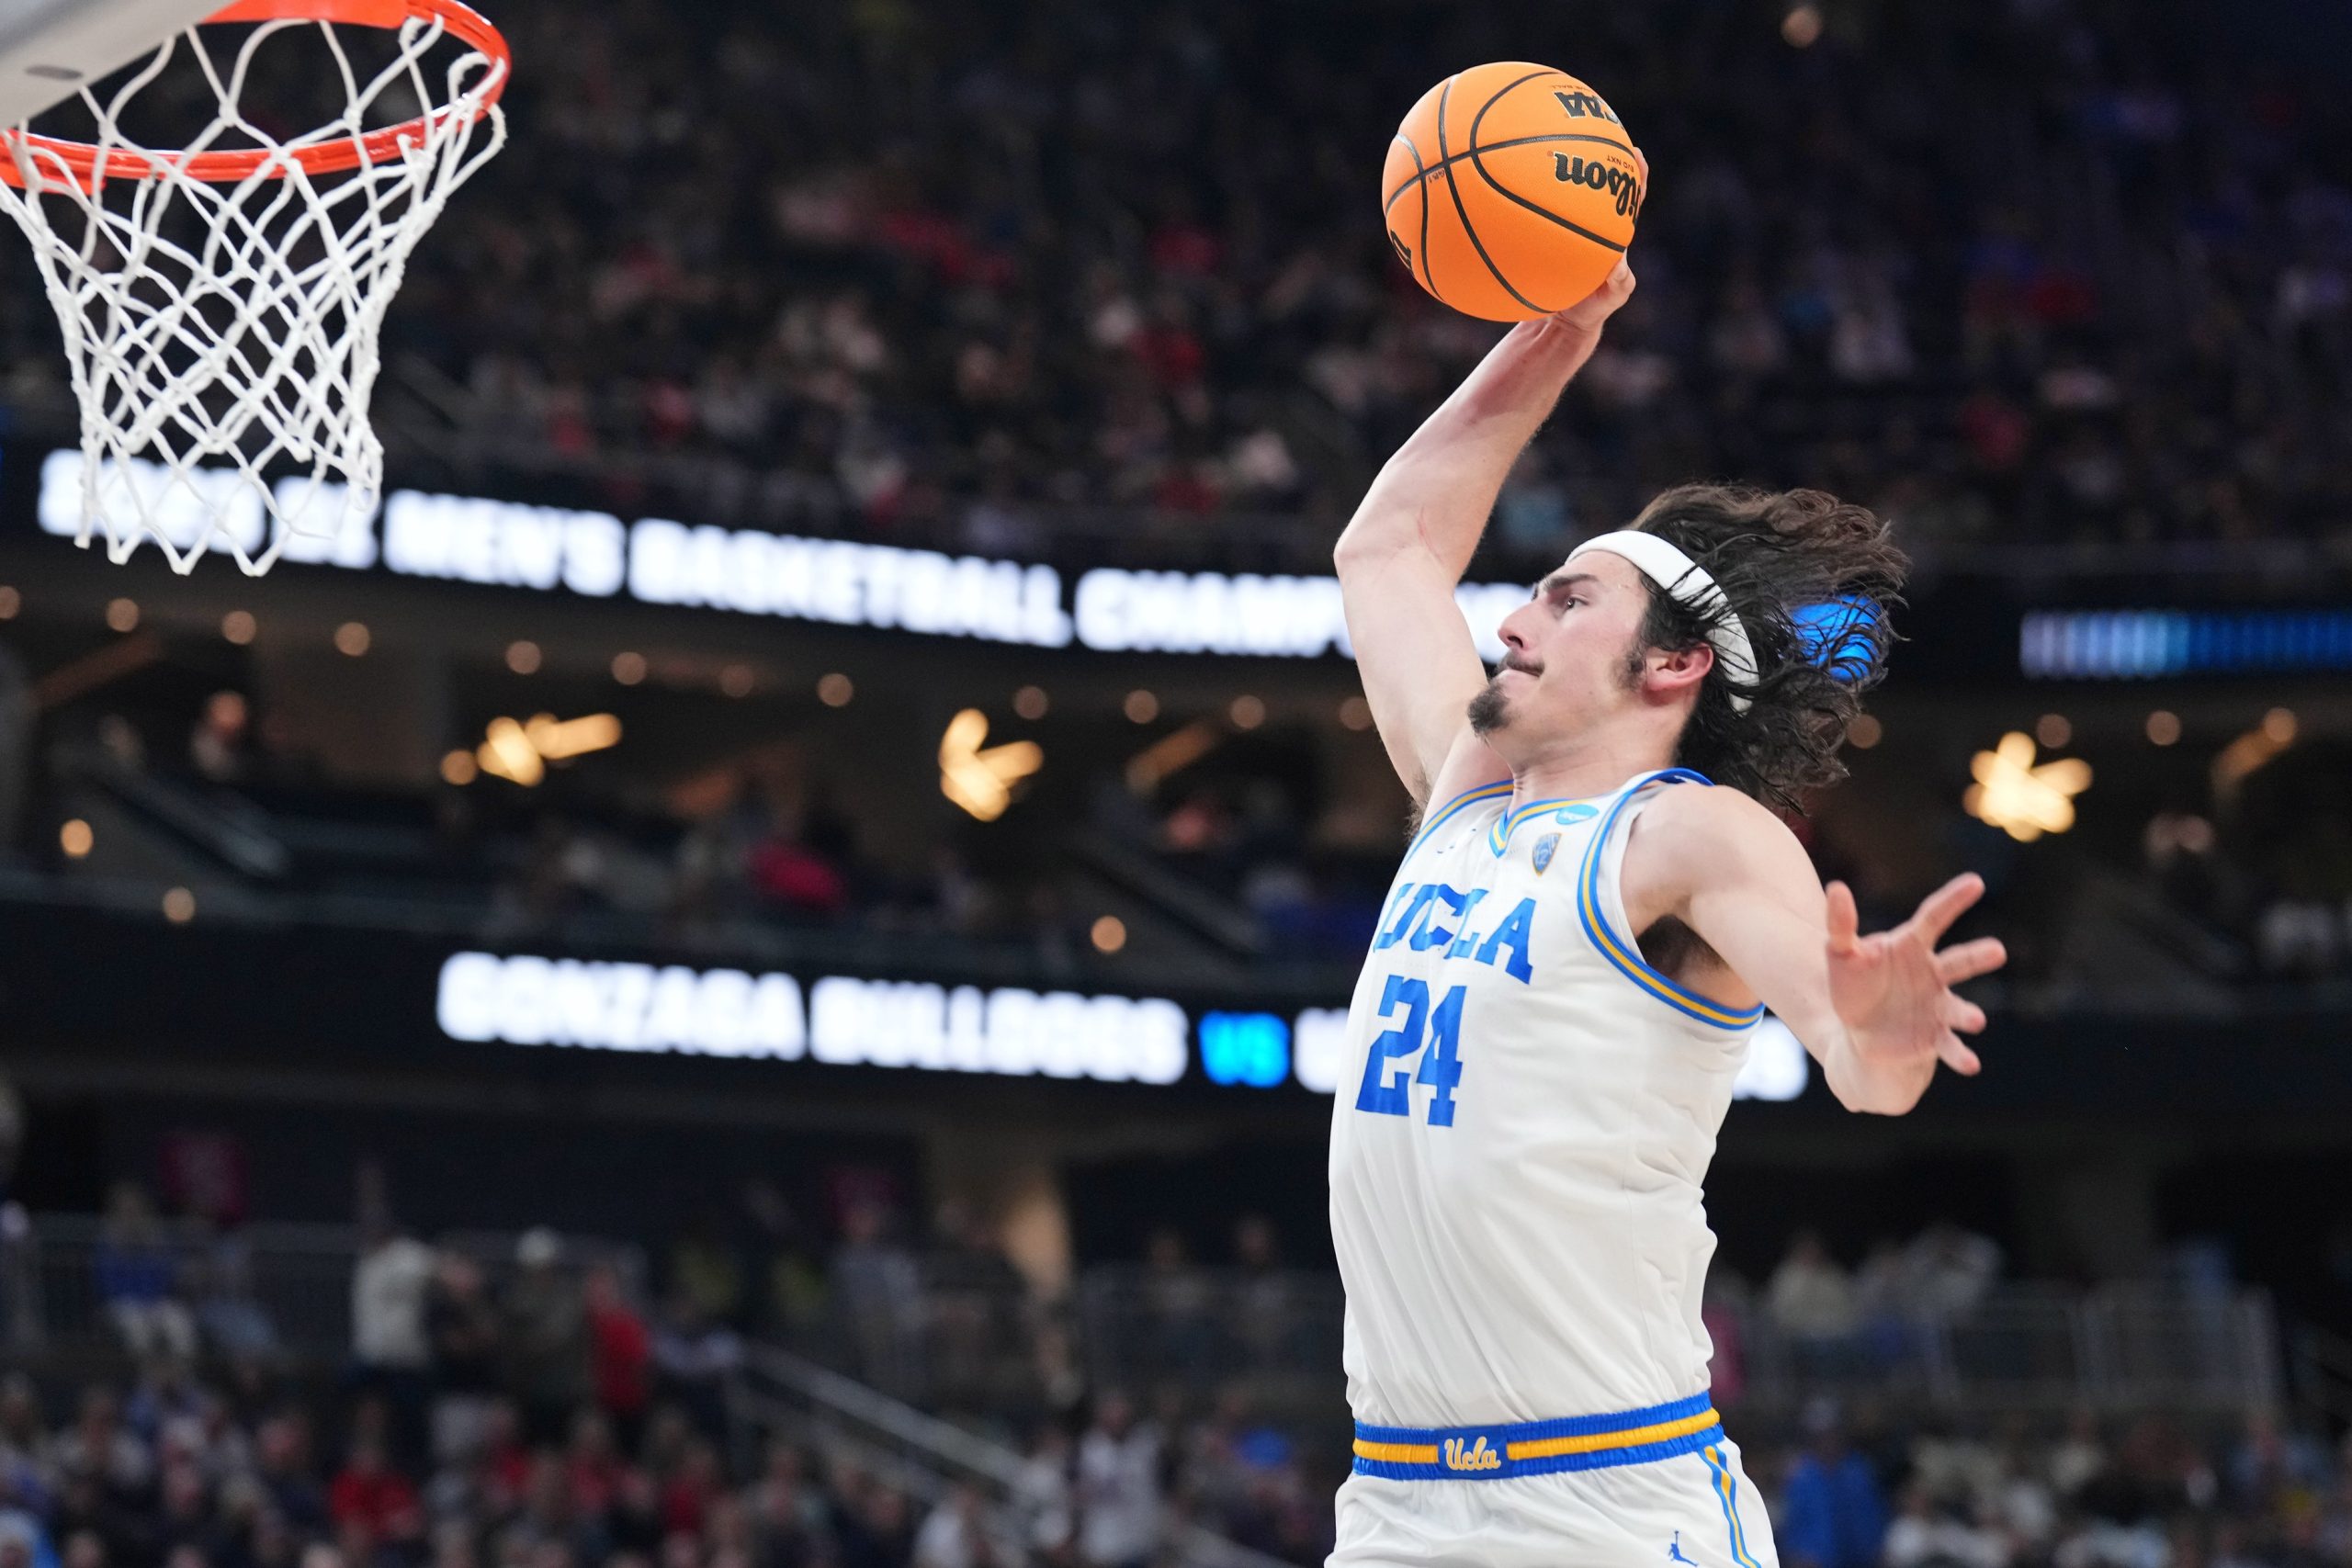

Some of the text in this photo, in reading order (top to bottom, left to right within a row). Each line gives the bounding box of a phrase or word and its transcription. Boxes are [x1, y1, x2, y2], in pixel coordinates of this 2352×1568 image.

[630, 518, 1072, 647] BASKETBALL
[1374, 883, 1536, 985] UCLA
[437, 952, 806, 1060] GONZAGA
[810, 977, 1187, 1085] BULLDOGS
[1355, 975, 1467, 1128] 24
[1444, 1436, 1501, 1471] Ucla
